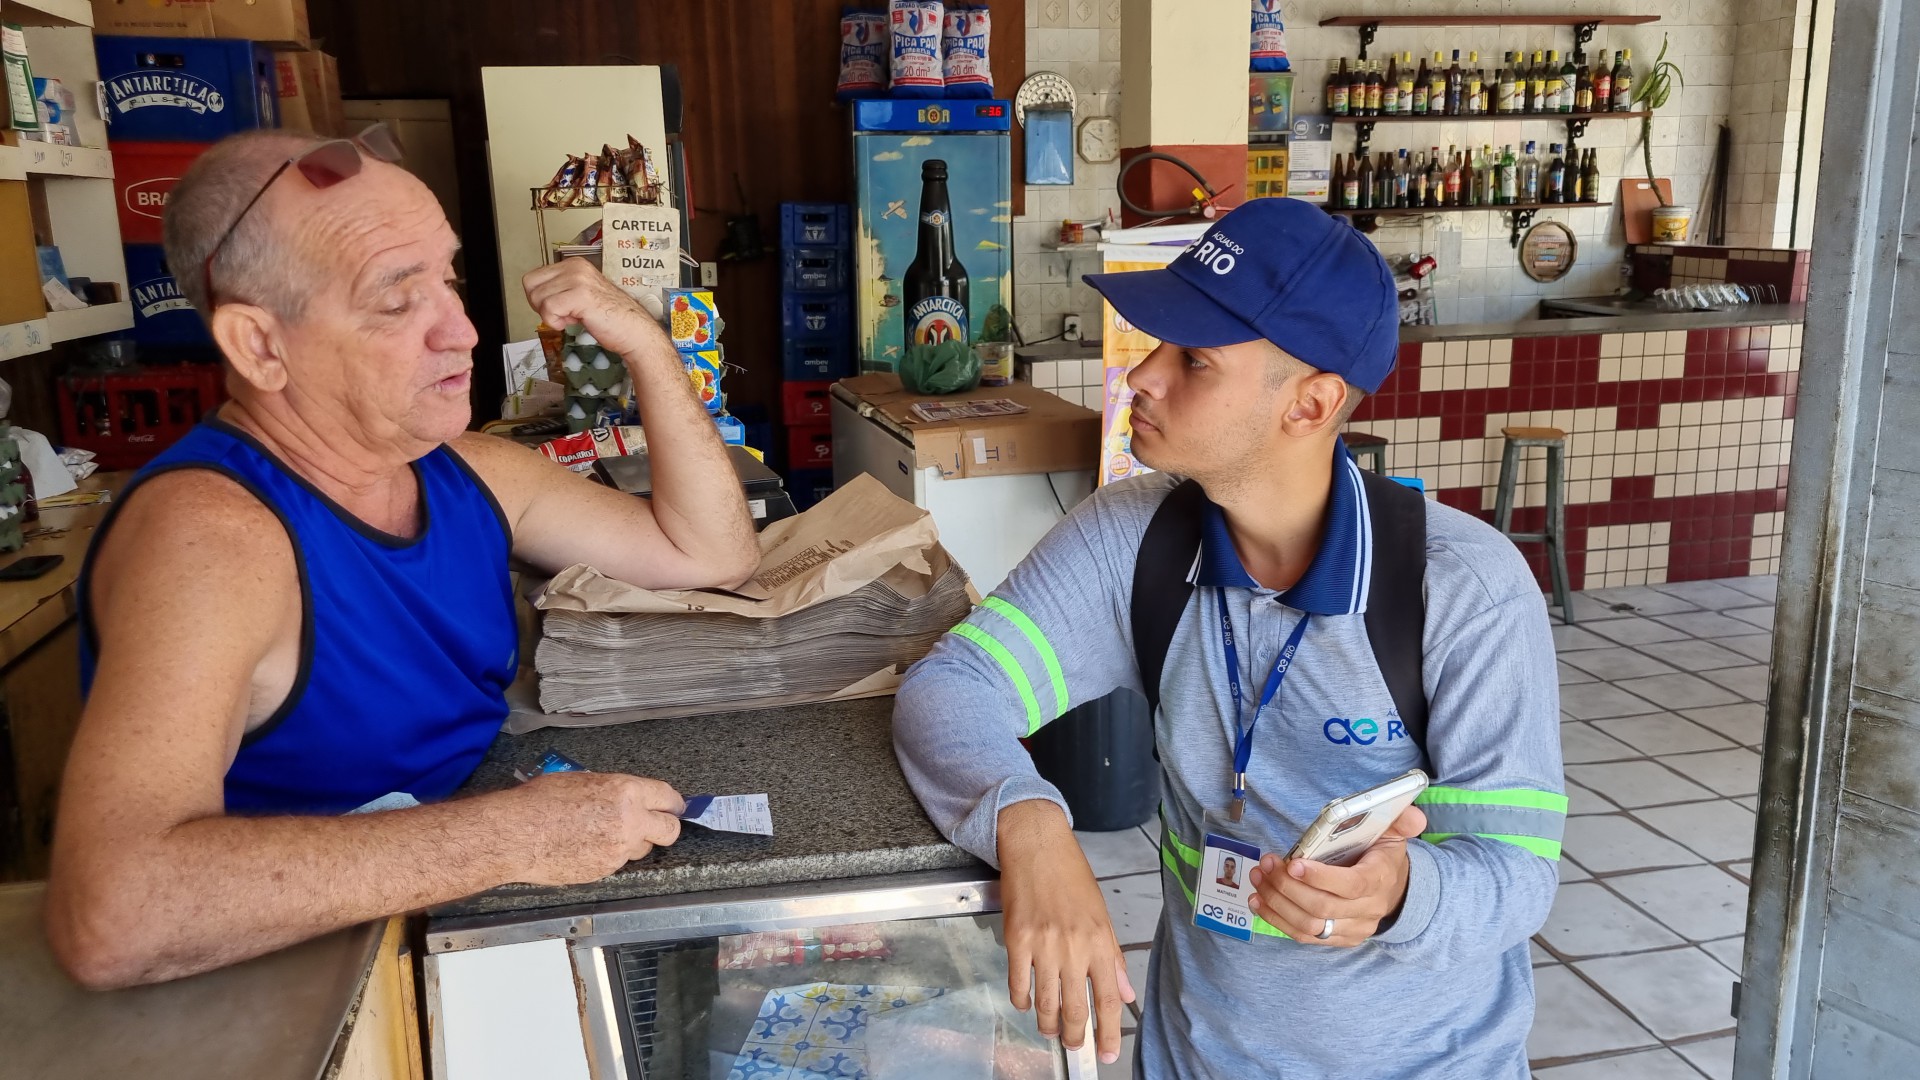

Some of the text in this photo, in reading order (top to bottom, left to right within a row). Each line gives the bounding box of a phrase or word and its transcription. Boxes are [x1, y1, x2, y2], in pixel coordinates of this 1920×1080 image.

[895, 35, 937, 50] PICA PAU
[967, 35, 985, 50] PAU
[903, 66, 915, 78] 20
[951, 65, 962, 76] 20
[110, 75, 209, 101] ANTARCTICA
[128, 96, 194, 110] PILSEN
[137, 191, 170, 206] BRA
[612, 219, 673, 233] CARTELA
[617, 239, 635, 250] R$:
[1211, 230, 1235, 248] ÁGUAS
[1230, 244, 1245, 255] DO
[622, 255, 665, 269] DÚZIA
[1193, 240, 1236, 276] RIO
[622, 276, 640, 287] R$:
[802, 272, 827, 280] ambev
[135, 282, 185, 307] ANTA
[154, 300, 193, 312] PILS
[912, 298, 965, 320] ANTARCTICA
[676, 341, 693, 349] RESH
[558, 449, 596, 463] COPARROZ
[1223, 631, 1234, 646] RIO
[1285, 644, 1296, 660] RIO
[1216, 888, 1238, 899] MATHEUS
[1226, 912, 1247, 928] RIO
